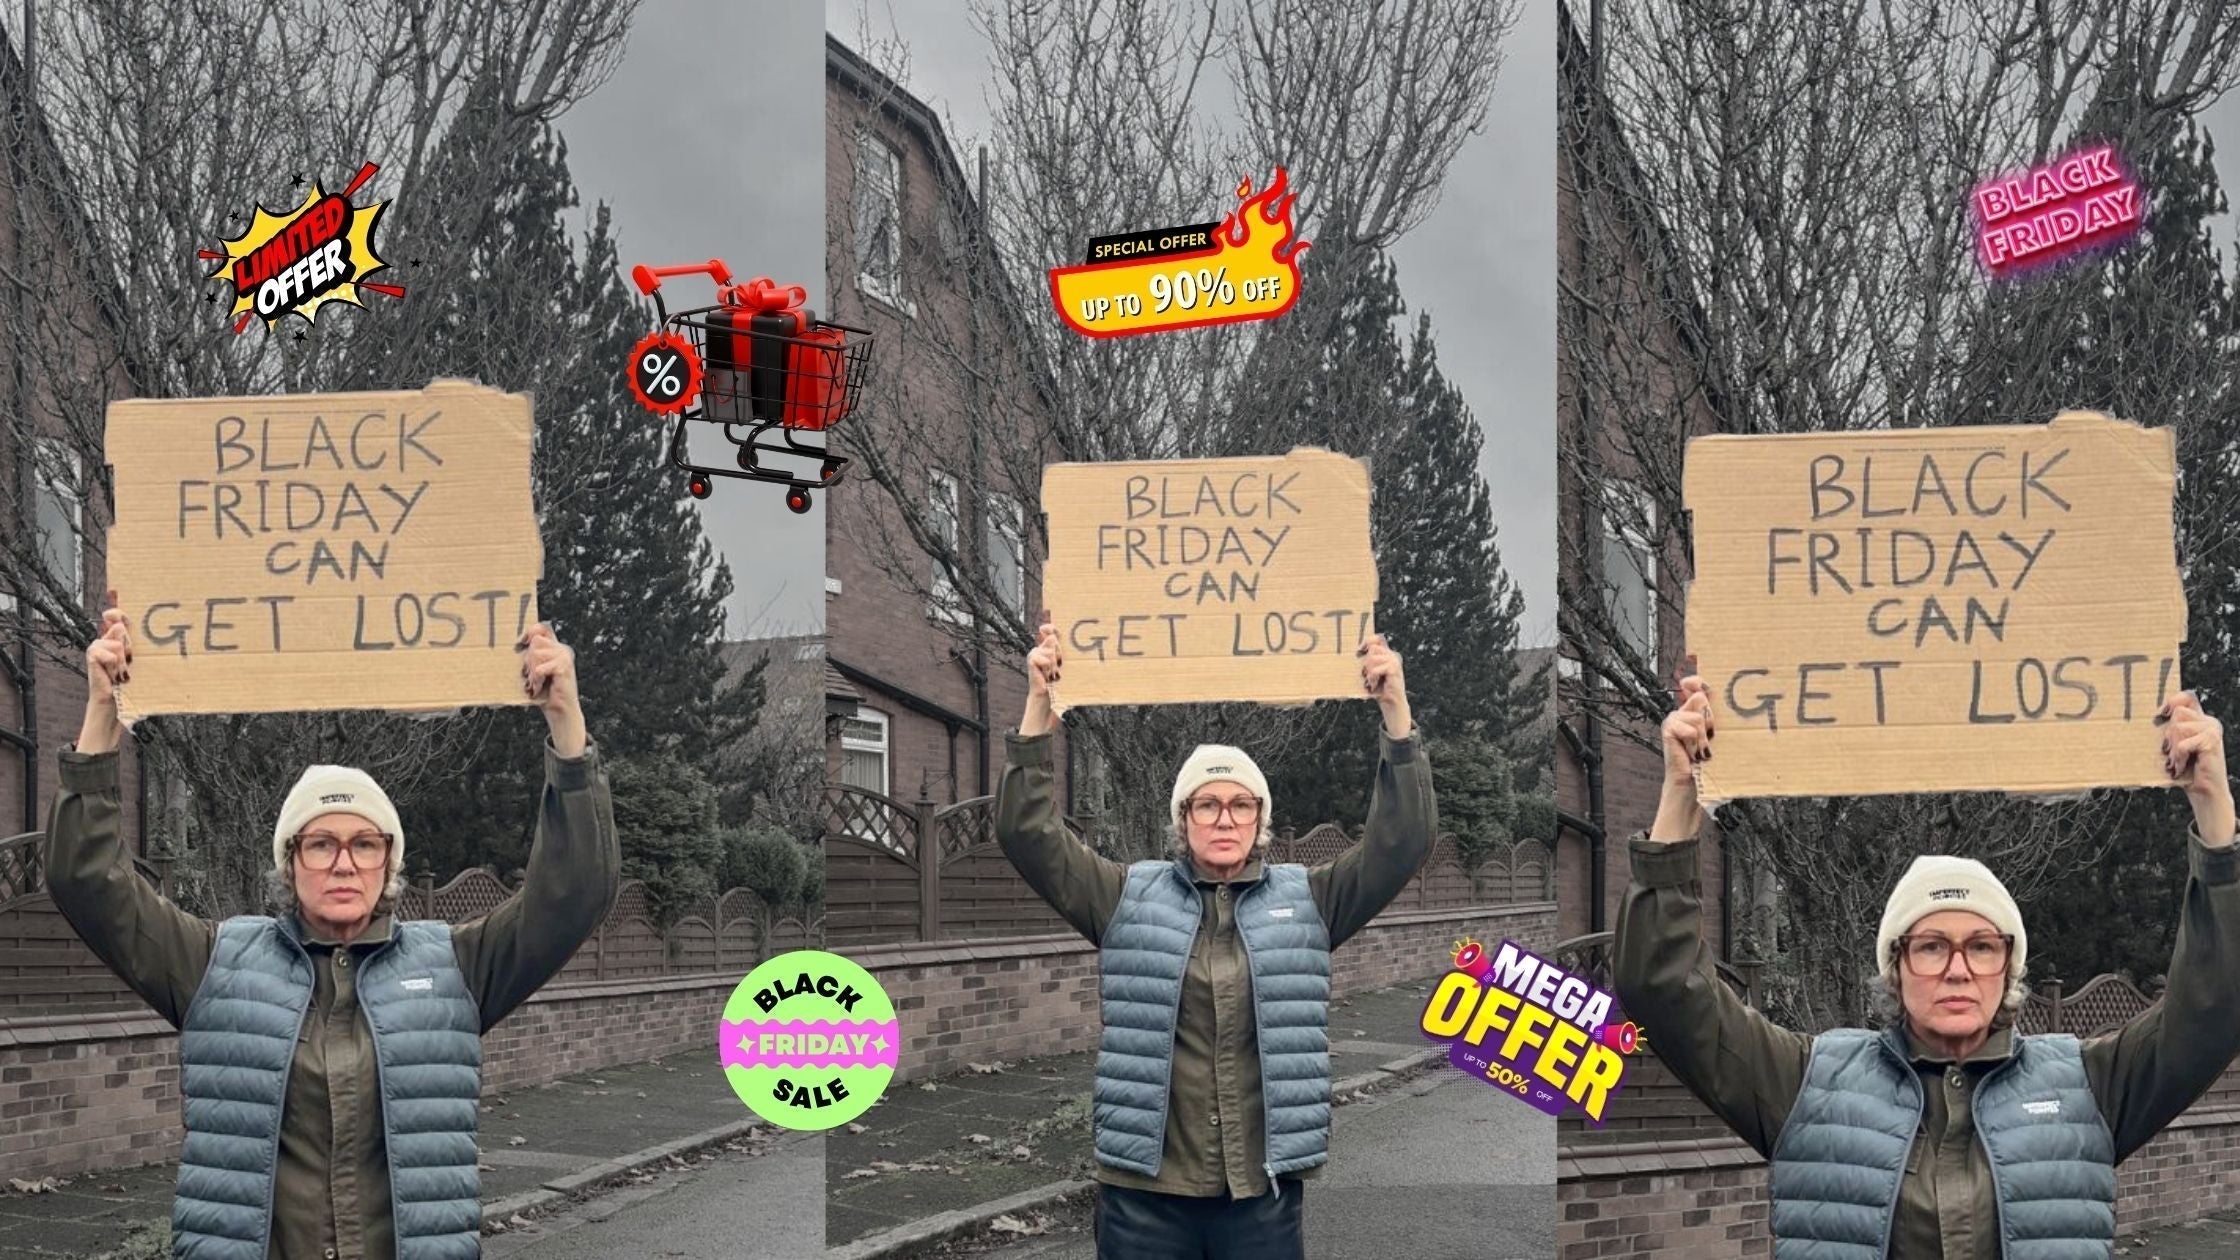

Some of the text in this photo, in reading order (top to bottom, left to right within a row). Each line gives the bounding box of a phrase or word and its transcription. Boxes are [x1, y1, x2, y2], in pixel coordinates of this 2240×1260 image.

[215, 411, 443, 473] BLACK
[179, 480, 430, 539] FRIDAY
[1126, 472, 1301, 520] BLACK
[1809, 448, 2072, 521] BLACK
[265, 538, 389, 585] CAN
[1098, 524, 1291, 570] FRIDAY
[1768, 527, 2055, 595] FRIDAY
[1164, 571, 1259, 605] CAN
[142, 591, 531, 658] GET LOST!
[1070, 609, 1370, 661] GET LOST!
[1867, 595, 2009, 648] CAN
[1725, 655, 2174, 732] GET LOST!
